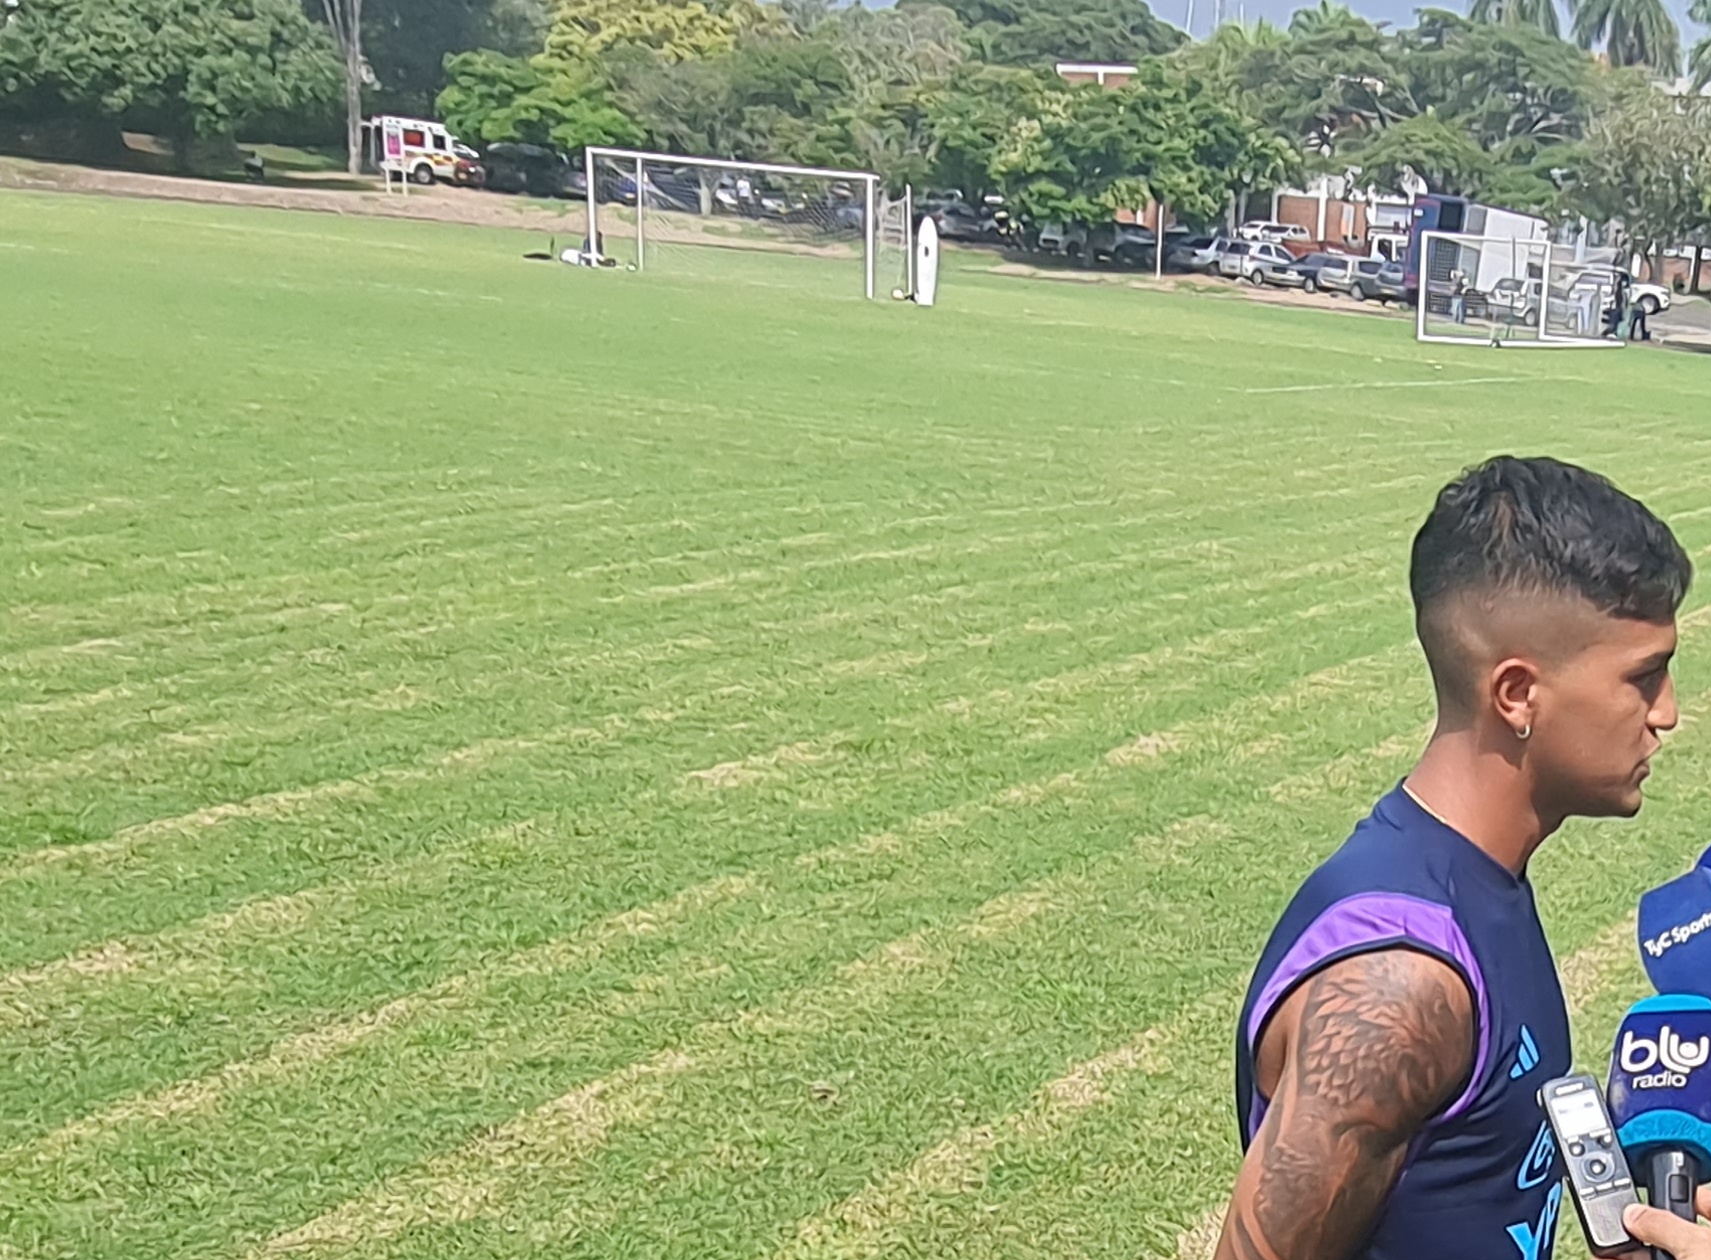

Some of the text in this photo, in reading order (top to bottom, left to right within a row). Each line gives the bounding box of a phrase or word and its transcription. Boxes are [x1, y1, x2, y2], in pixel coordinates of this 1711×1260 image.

[1643, 932, 1672, 957] TyC
[1620, 1026, 1709, 1074] blu
[1632, 1071, 1687, 1089] radio
